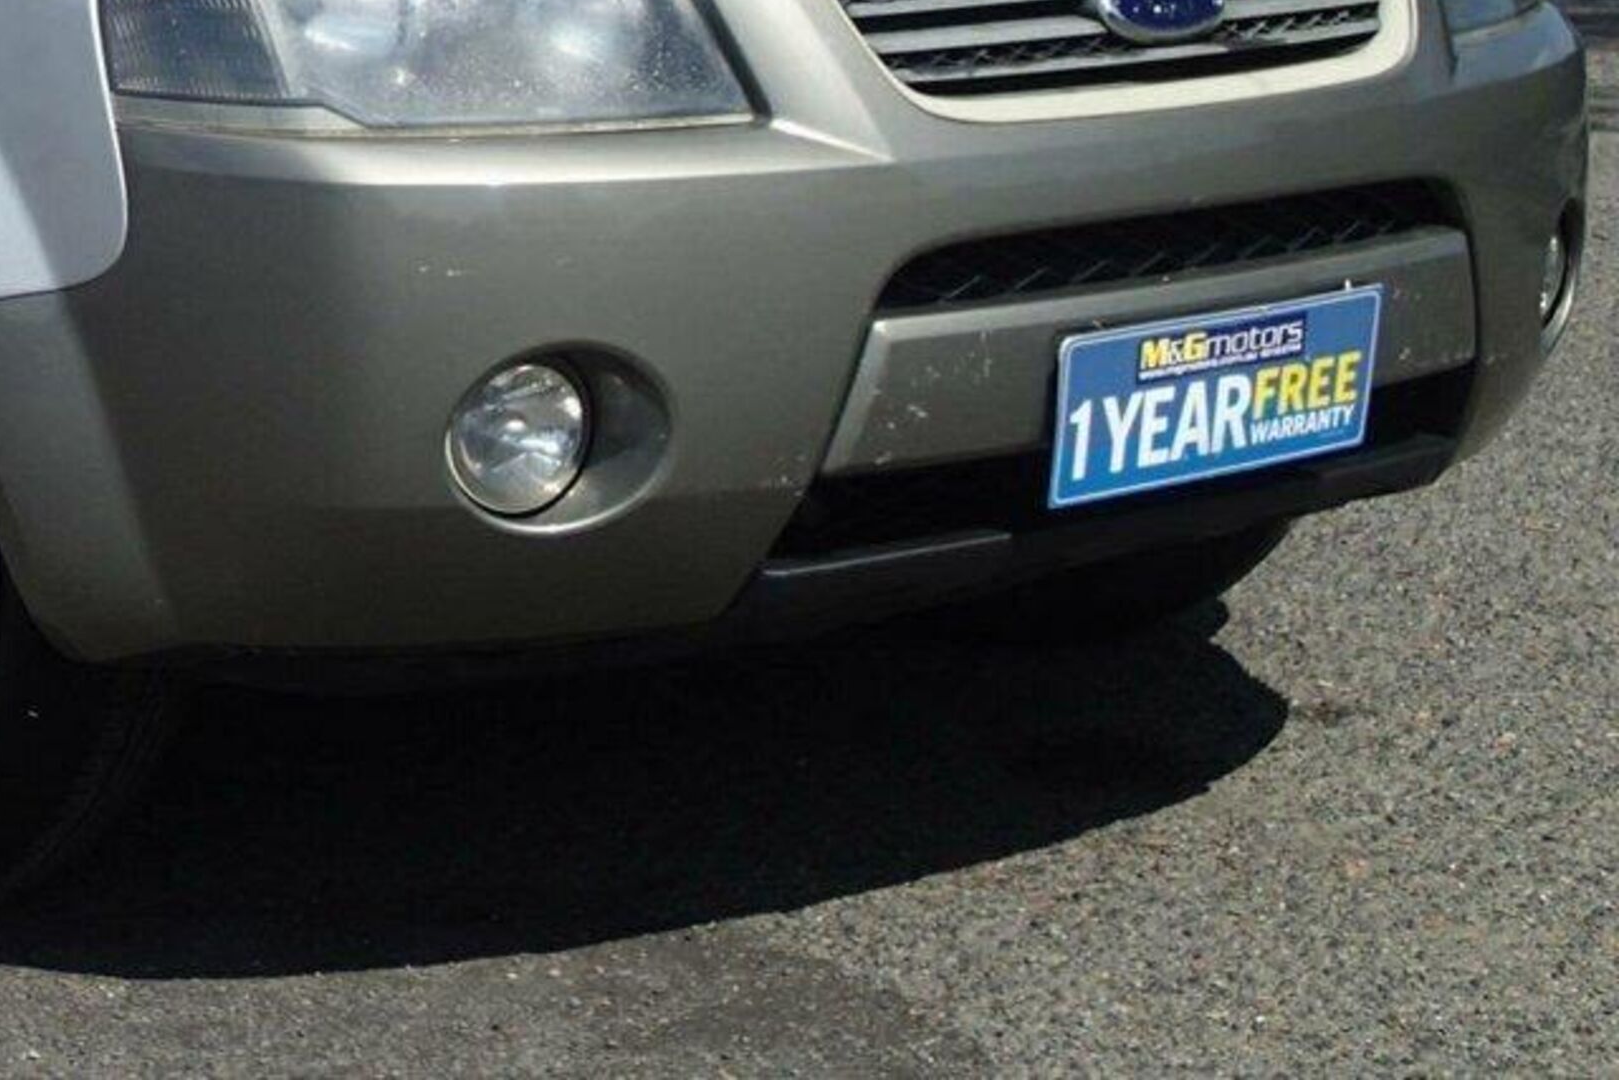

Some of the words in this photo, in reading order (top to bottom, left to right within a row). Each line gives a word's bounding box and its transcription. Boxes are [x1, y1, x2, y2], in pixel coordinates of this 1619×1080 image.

[1070, 399, 1093, 481] 1
[1103, 374, 1251, 473] YEAR
[1252, 350, 1362, 420] FREE
[1250, 403, 1356, 445] WARRANTY
